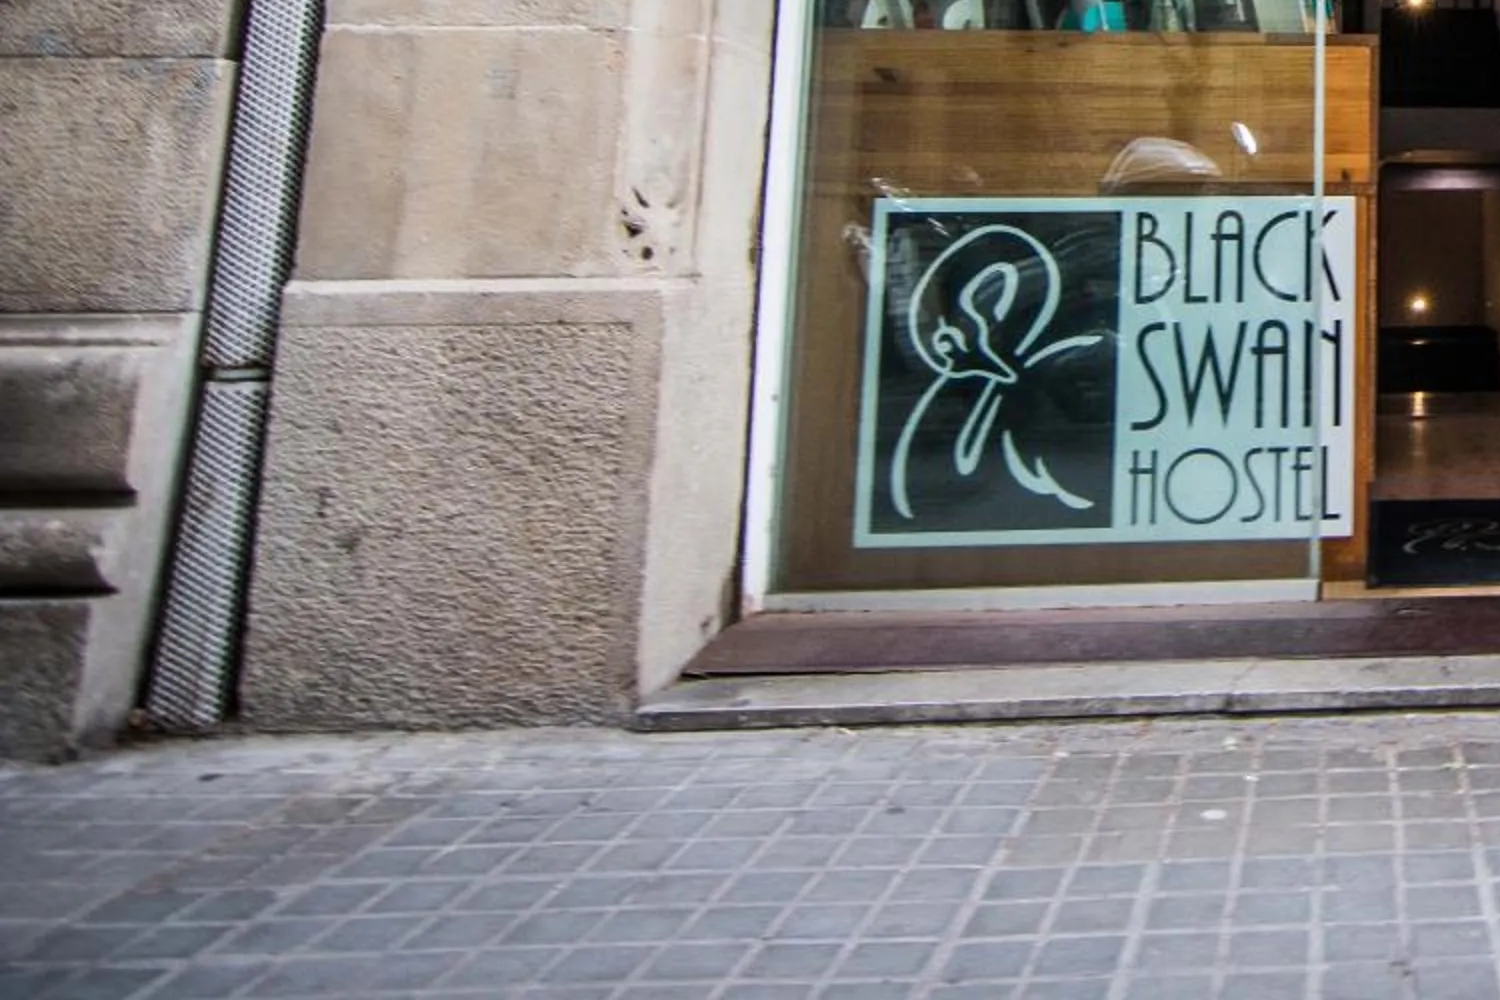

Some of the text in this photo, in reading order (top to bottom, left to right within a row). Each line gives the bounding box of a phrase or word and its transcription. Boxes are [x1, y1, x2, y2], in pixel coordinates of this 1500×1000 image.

[1134, 210, 1341, 304] BLACK
[1130, 319, 1342, 430] SWAN
[1129, 446, 1342, 526] HOSTEL
